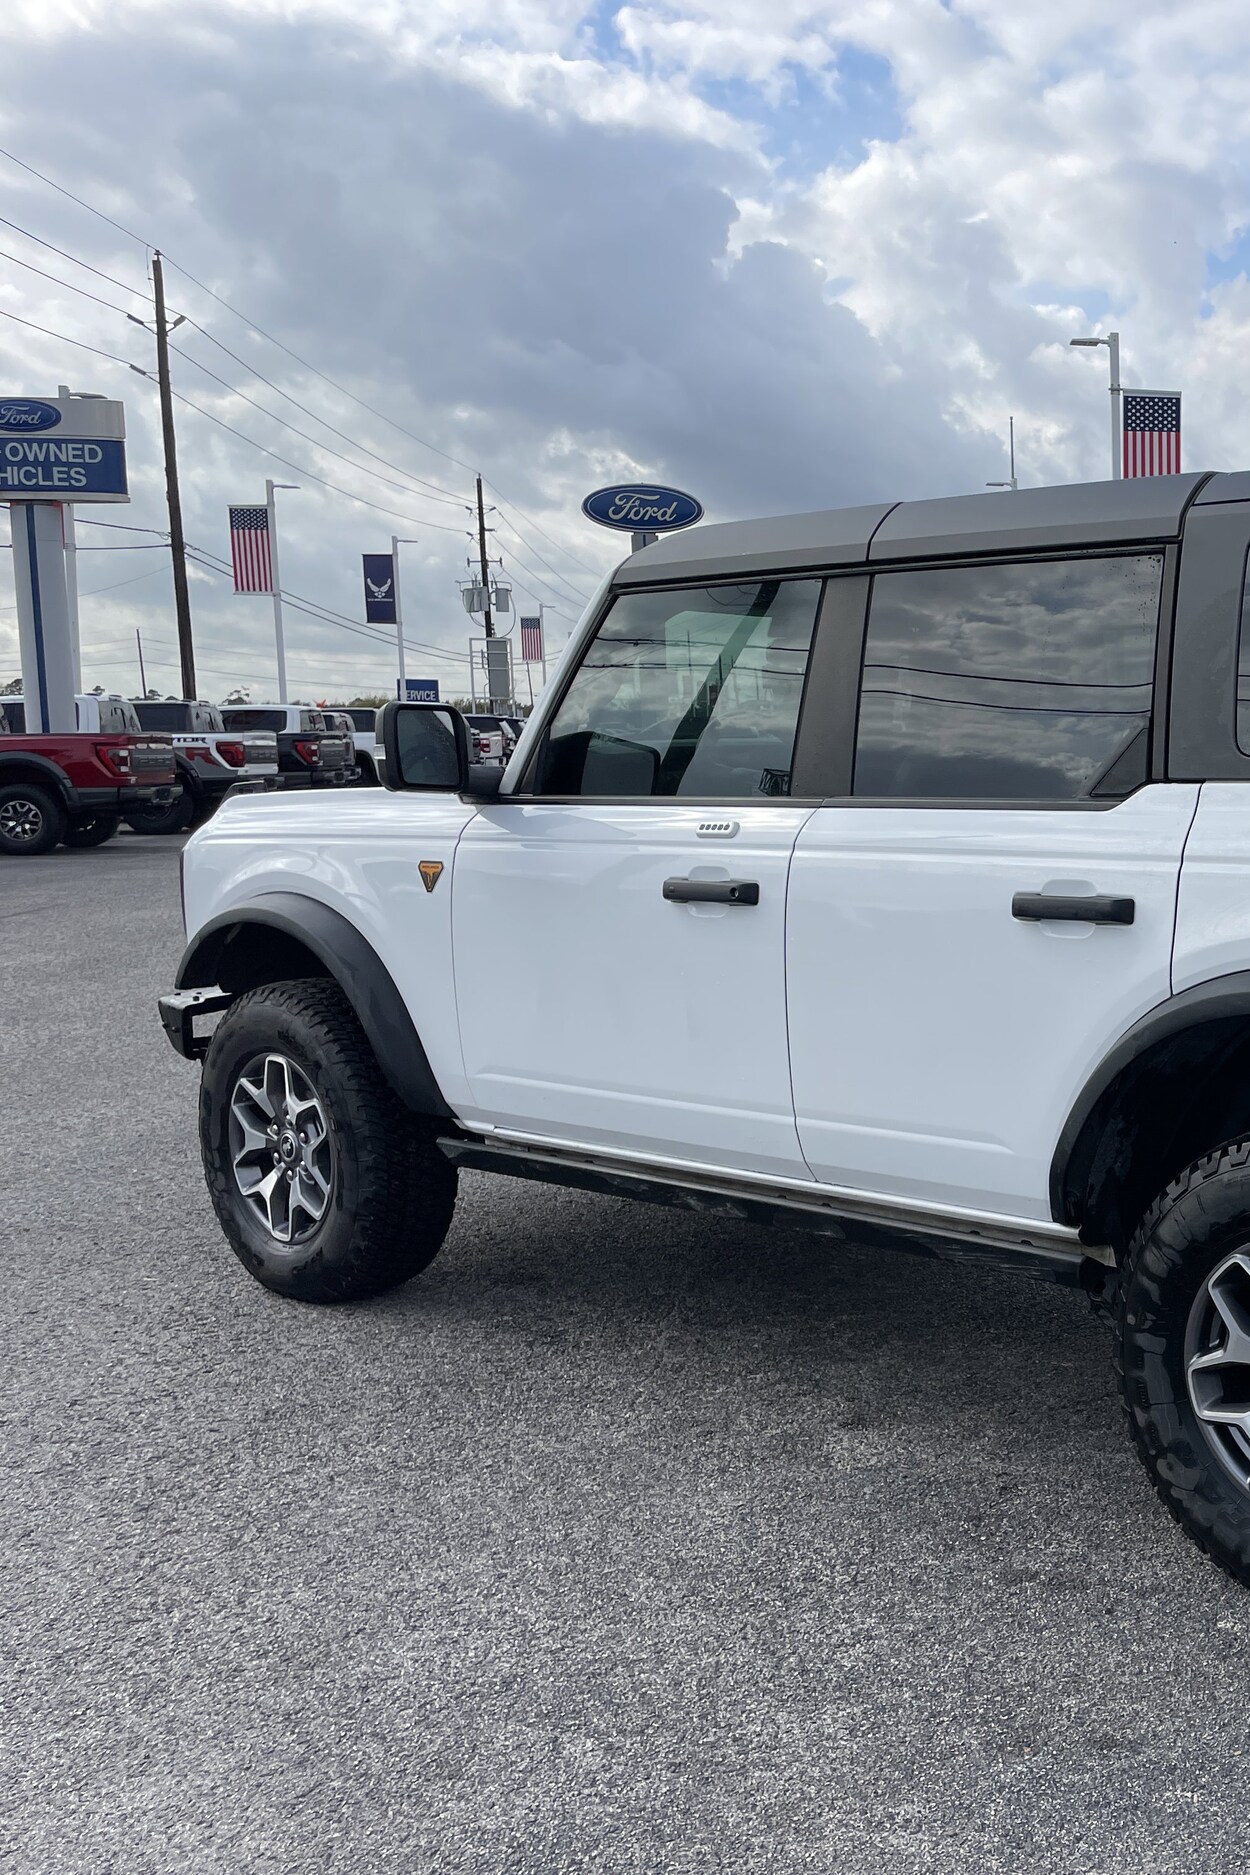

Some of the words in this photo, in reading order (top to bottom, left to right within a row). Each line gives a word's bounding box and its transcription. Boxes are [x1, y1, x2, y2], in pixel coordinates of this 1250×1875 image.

[0, 405, 42, 424] Ford
[608, 492, 678, 522] Ford
[404, 689, 437, 701] ERVICE
